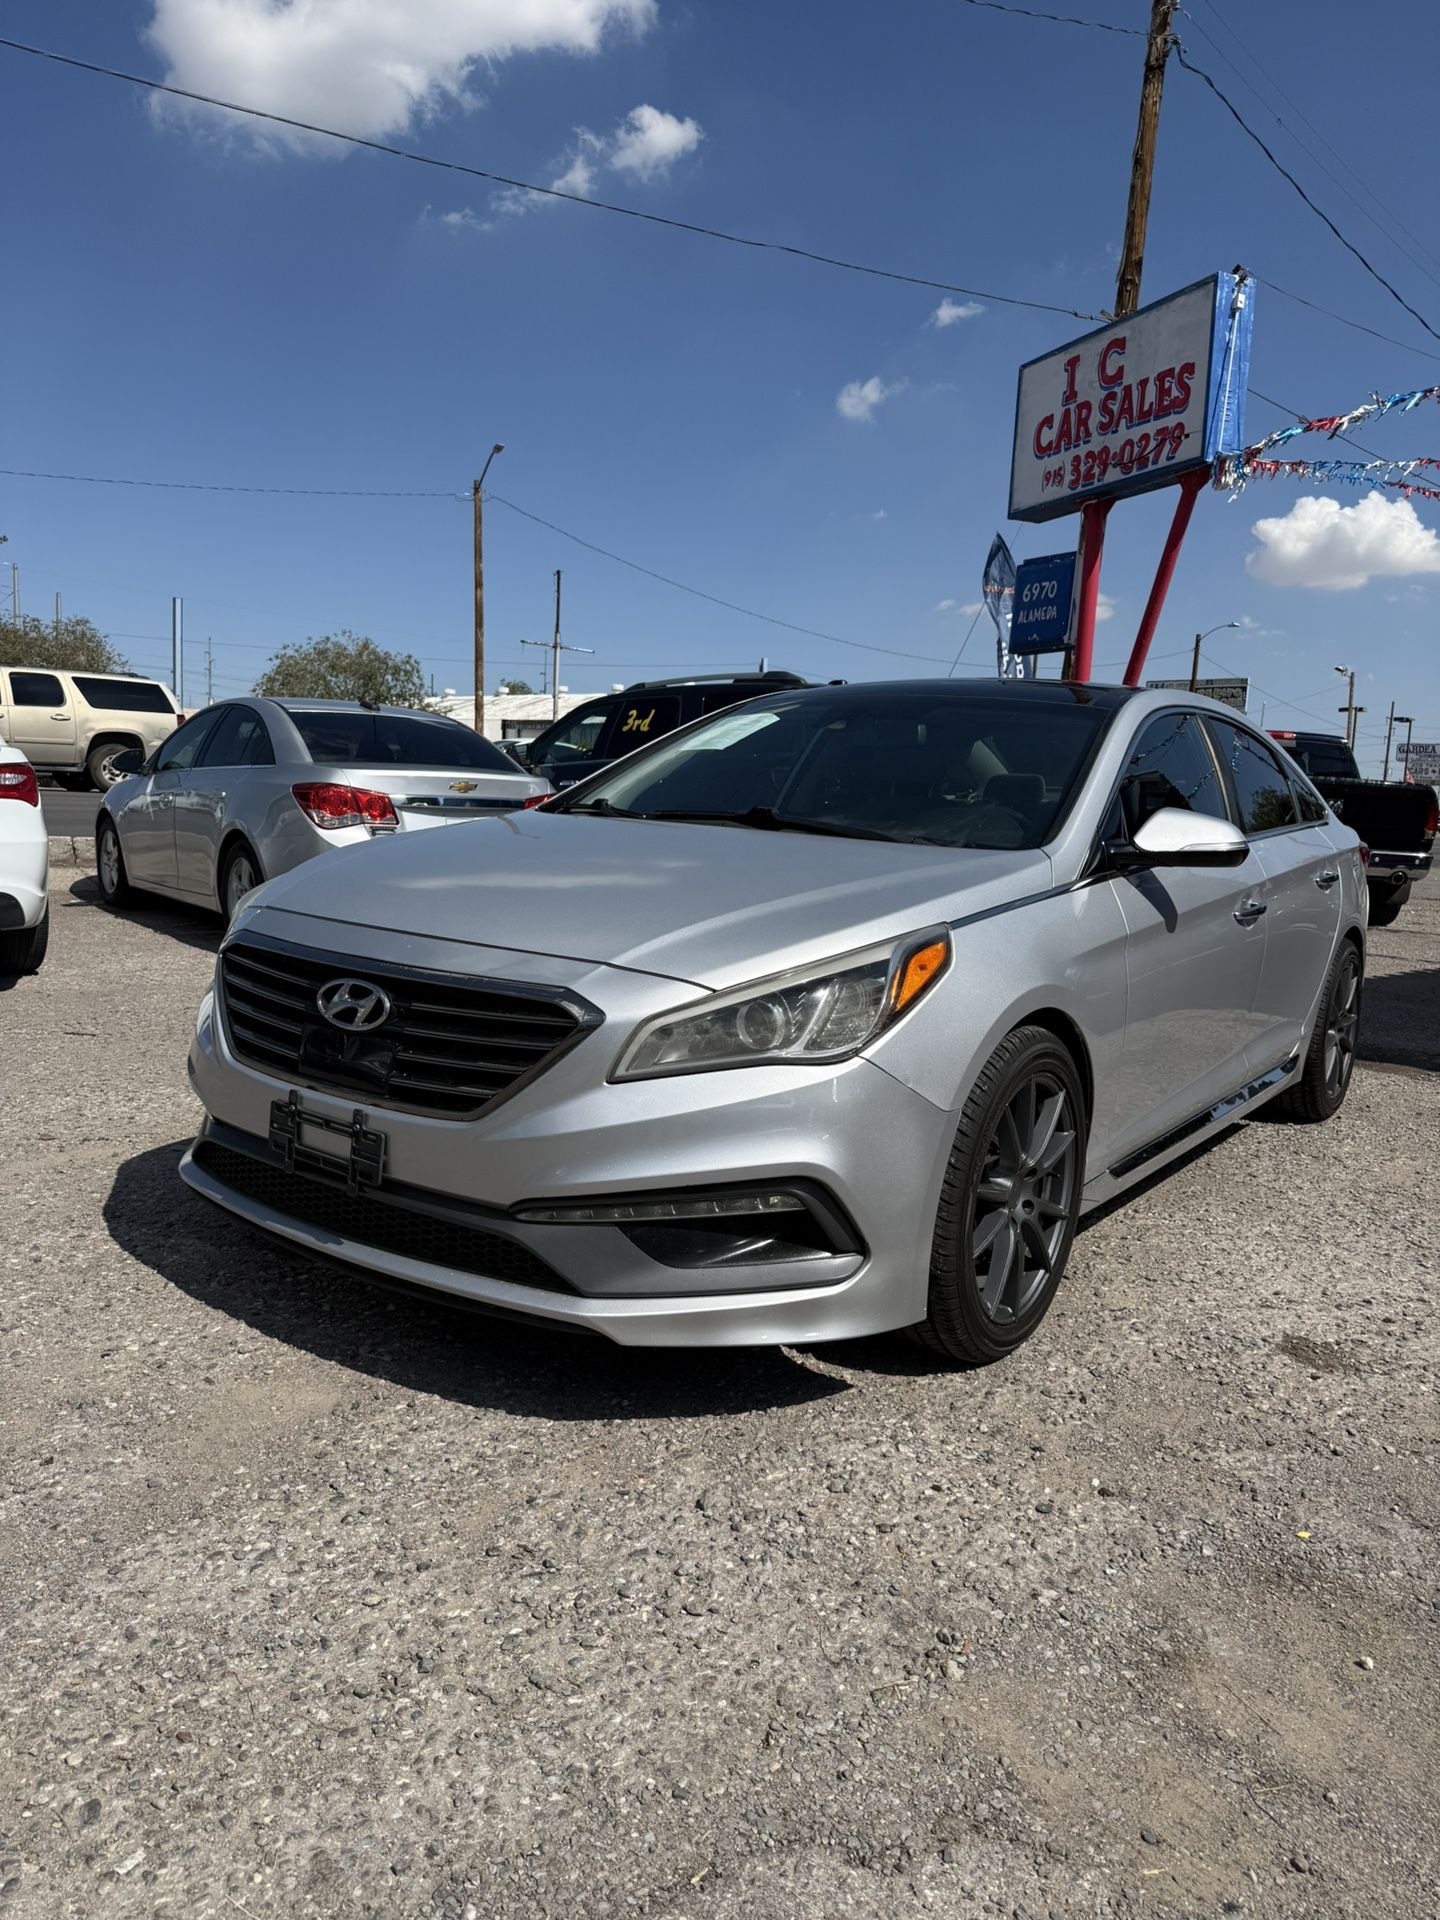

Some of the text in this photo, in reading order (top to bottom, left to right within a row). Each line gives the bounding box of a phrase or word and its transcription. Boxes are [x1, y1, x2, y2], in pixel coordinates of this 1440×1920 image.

[1062, 337, 1127, 405] I C
[1033, 362, 1195, 459] CAR SALES
[1042, 461, 1066, 492] (915)
[1022, 580, 1058, 602] 6970
[1017, 606, 1057, 624] ALAMEDA
[622, 709, 655, 732] 3rd
[1398, 744, 1437, 755] GARDEA
